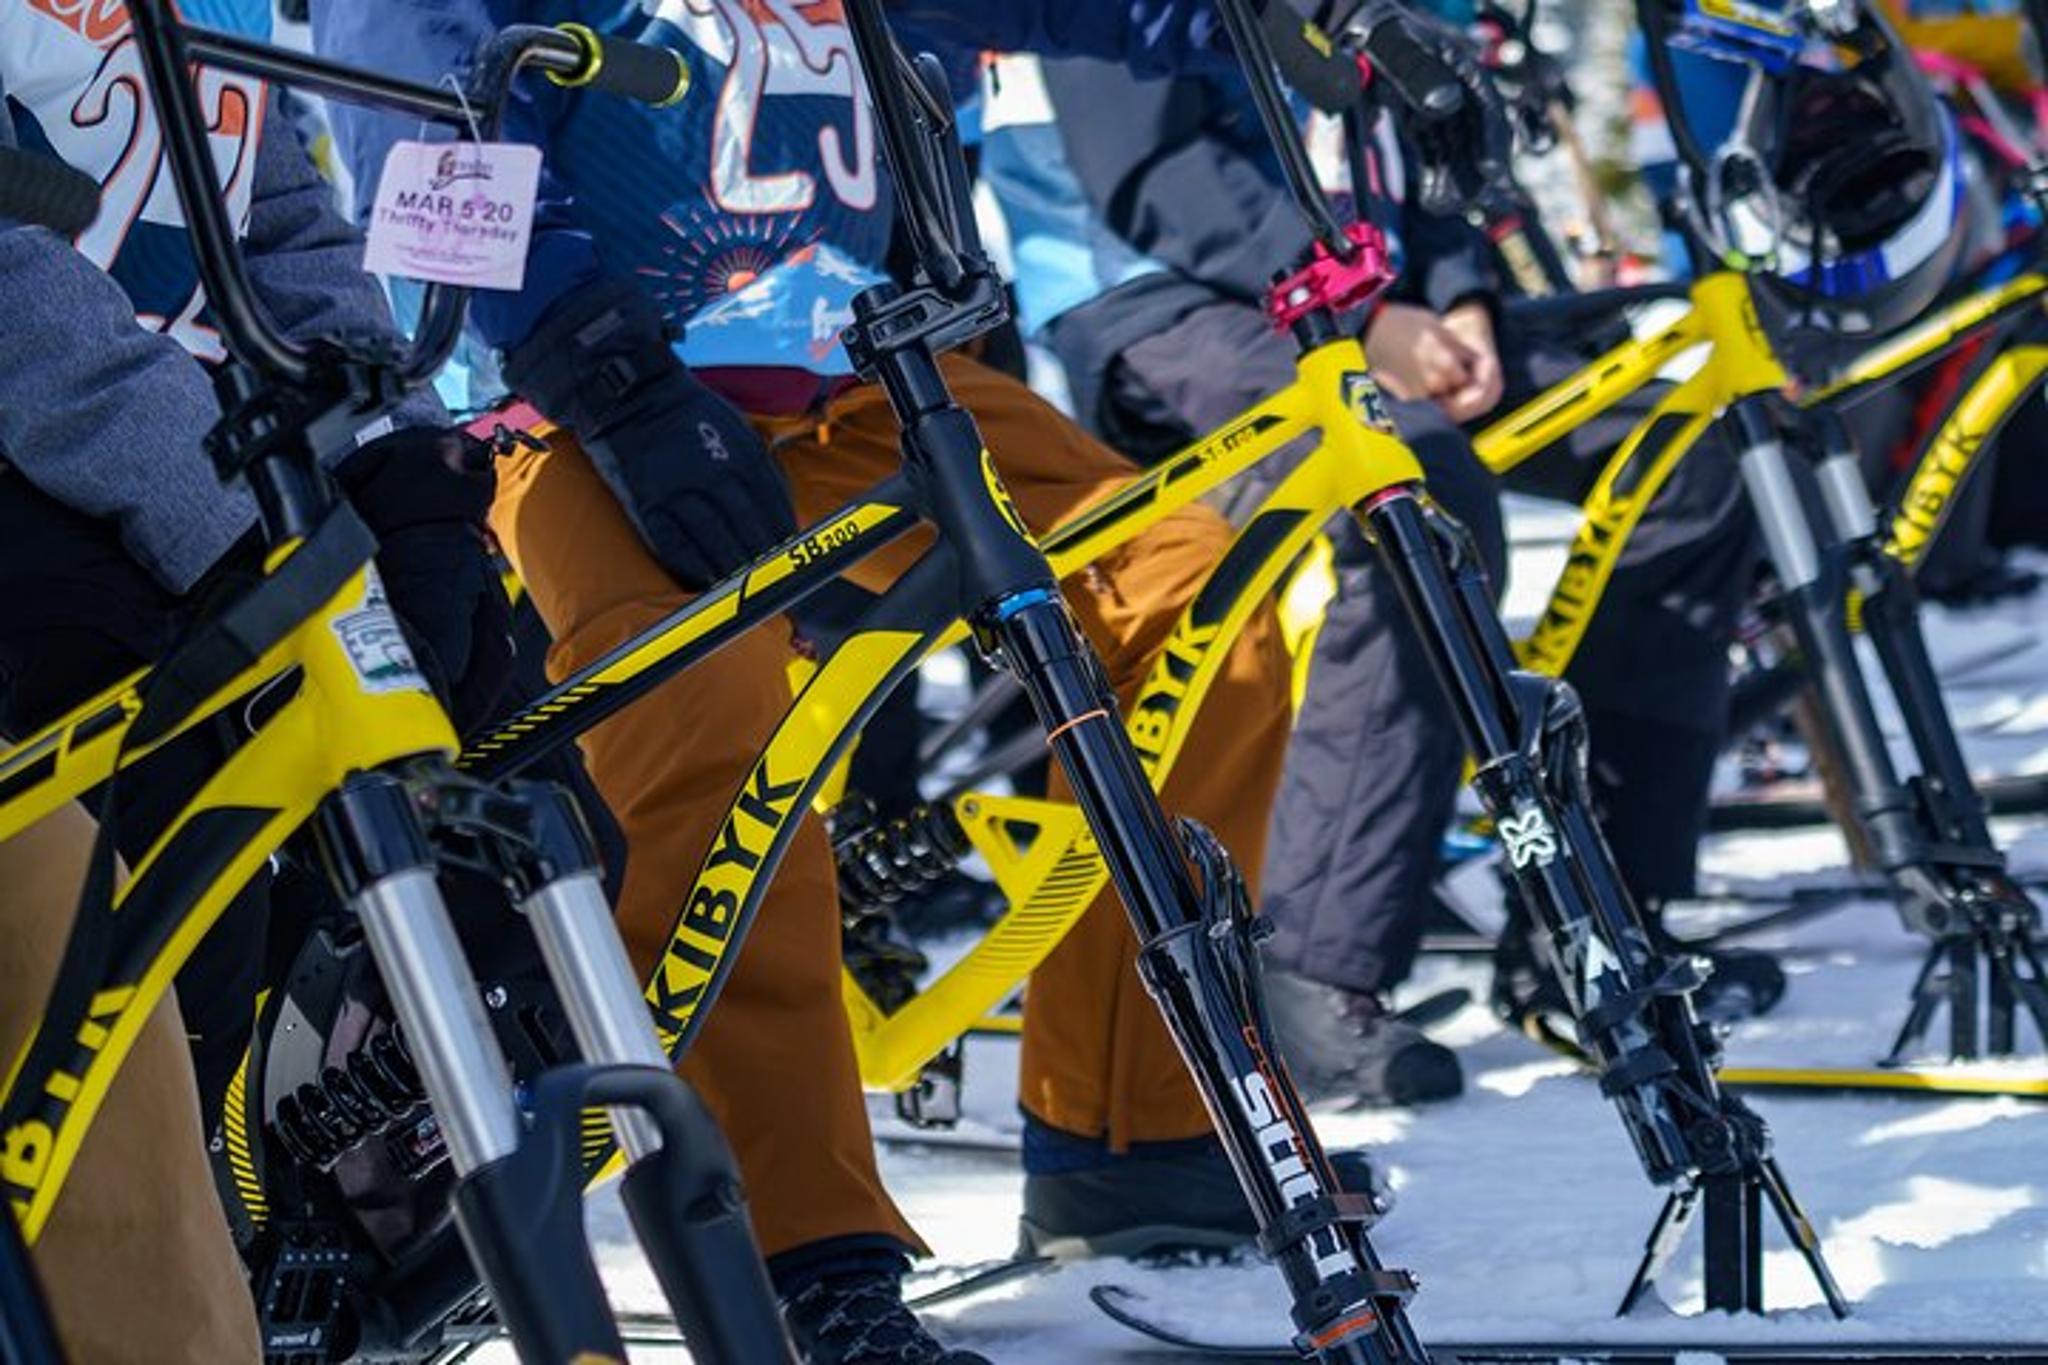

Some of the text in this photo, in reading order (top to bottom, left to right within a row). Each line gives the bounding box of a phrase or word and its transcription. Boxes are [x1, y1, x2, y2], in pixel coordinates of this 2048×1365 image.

[395, 190, 514, 223] MAR 5 20
[644, 755, 806, 1036] KIBYK
